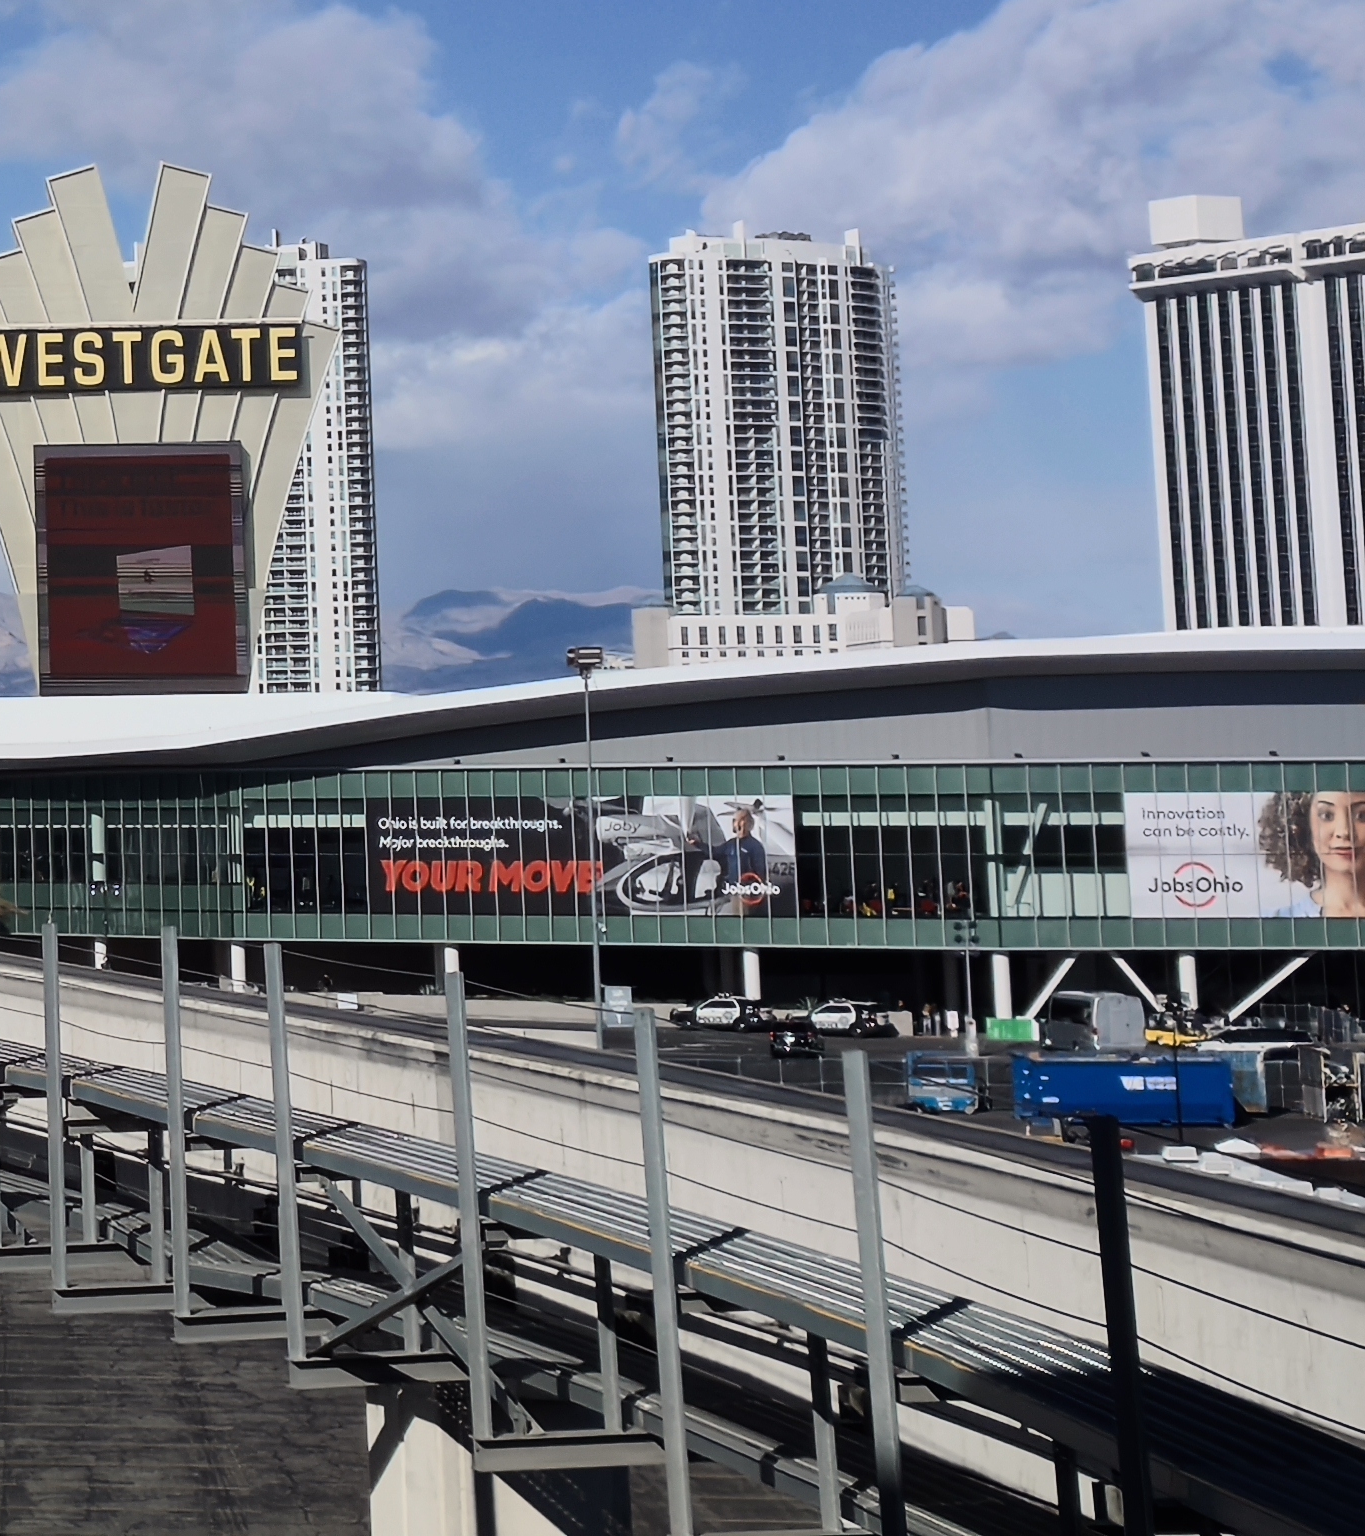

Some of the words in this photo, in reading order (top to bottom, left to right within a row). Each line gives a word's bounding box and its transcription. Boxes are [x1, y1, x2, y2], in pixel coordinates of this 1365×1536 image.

[377, 816, 407, 830] Ohio
[408, 816, 418, 830] is
[420, 816, 448, 830] built
[449, 816, 468, 830] for
[469, 816, 563, 833] breakthroughs.
[604, 821, 641, 834] Joby
[1142, 827, 1172, 837] can
[1175, 825, 1195, 837] be
[1198, 824, 1250, 840] costly.
[378, 835, 415, 852] Major
[415, 835, 510, 852] breakthroughs.
[380, 860, 483, 892] YOUR
[488, 860, 603, 893] MOVE
[1148, 875, 1244, 893] JobsOhio
[721, 881, 781, 895] JobsOhio
